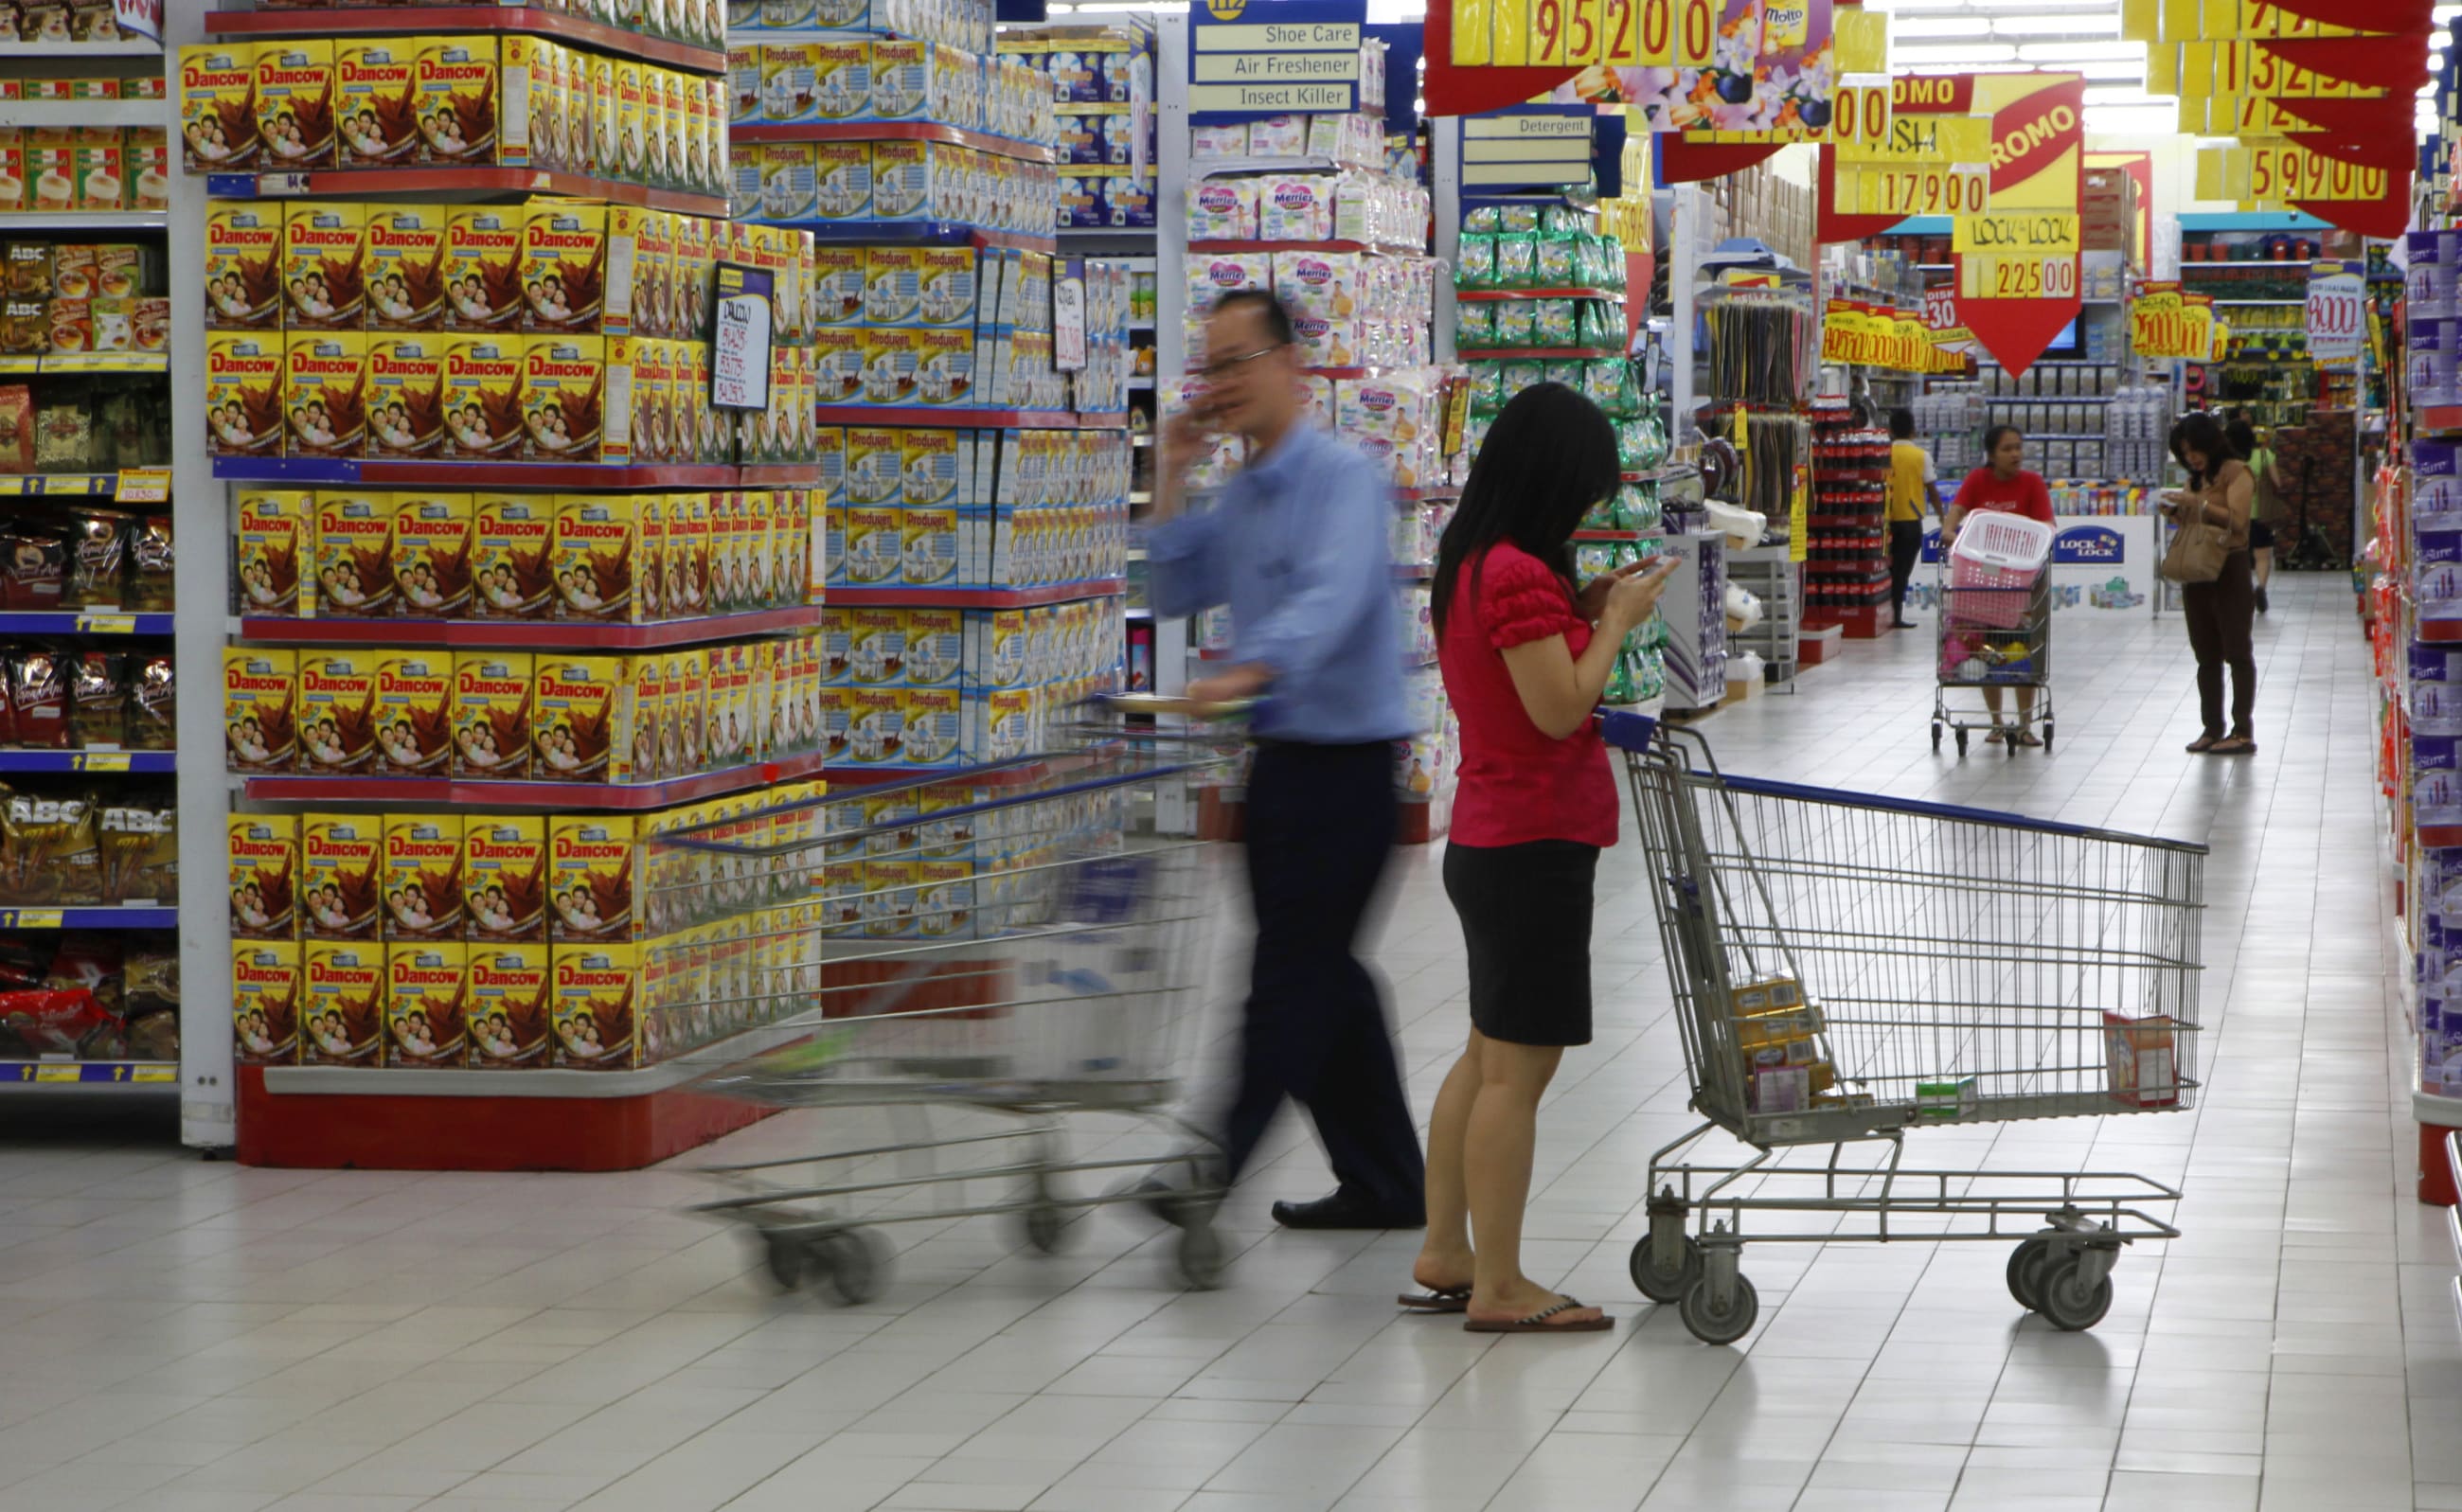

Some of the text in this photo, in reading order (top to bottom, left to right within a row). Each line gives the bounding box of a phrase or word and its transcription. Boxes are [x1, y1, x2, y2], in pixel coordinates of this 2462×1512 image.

[1764, 7, 1803, 24] Molto
[1265, 25, 1353, 44] Shoe Care
[260, 64, 323, 84] Dancow
[343, 62, 406, 80] Dancow
[421, 61, 485, 80] Dancow
[1235, 57, 1351, 75] Air Freshener
[186, 68, 248, 87] Dancow
[1240, 86, 1344, 105] Insect Killer
[1893, 79, 1954, 104] OMO
[1520, 118, 1584, 135] Detergent
[1989, 105, 2075, 170] ROMO
[1274, 191, 1313, 205] Merries
[212, 224, 273, 242] Dancow
[292, 224, 356, 243] Dancow
[372, 225, 435, 245] Dancow
[453, 226, 515, 245] Dancow
[530, 227, 595, 247] Dancow
[10, 246, 45, 260] ABC
[1210, 269, 1245, 281] Merries
[1296, 267, 1332, 279] Merries
[6, 302, 43, 316] ABC
[212, 353, 274, 372] Dancow
[294, 353, 357, 372] Dancow
[373, 354, 437, 374] Dancow
[450, 355, 514, 374] Dancow
[530, 356, 594, 376] Dancow
[1360, 394, 1395, 406] Merries
[243, 512, 291, 530] Dancow
[324, 513, 385, 532] Dancow
[400, 515, 463, 534] Dancow
[482, 516, 544, 535] Dancow
[561, 517, 624, 536] Dancow
[2060, 540, 2114, 558] LOCK LOCK
[230, 670, 285, 689] Dancow
[305, 671, 366, 690] Dancow
[381, 672, 442, 692] Dancow
[460, 673, 523, 693] Dancow
[541, 676, 603, 697] Dancow
[9, 800, 85, 824] ABC
[101, 808, 173, 833] ABC
[234, 836, 284, 854] Dancow
[309, 836, 369, 856] Dancow
[390, 837, 455, 856] Dancow
[471, 838, 535, 857] Dancow
[557, 839, 623, 857] Dancow
[240, 963, 290, 981] Dancow
[312, 962, 372, 982] Dancow
[396, 964, 457, 983] Dancow
[475, 966, 539, 985] Dancow
[561, 966, 625, 985] Dancow
